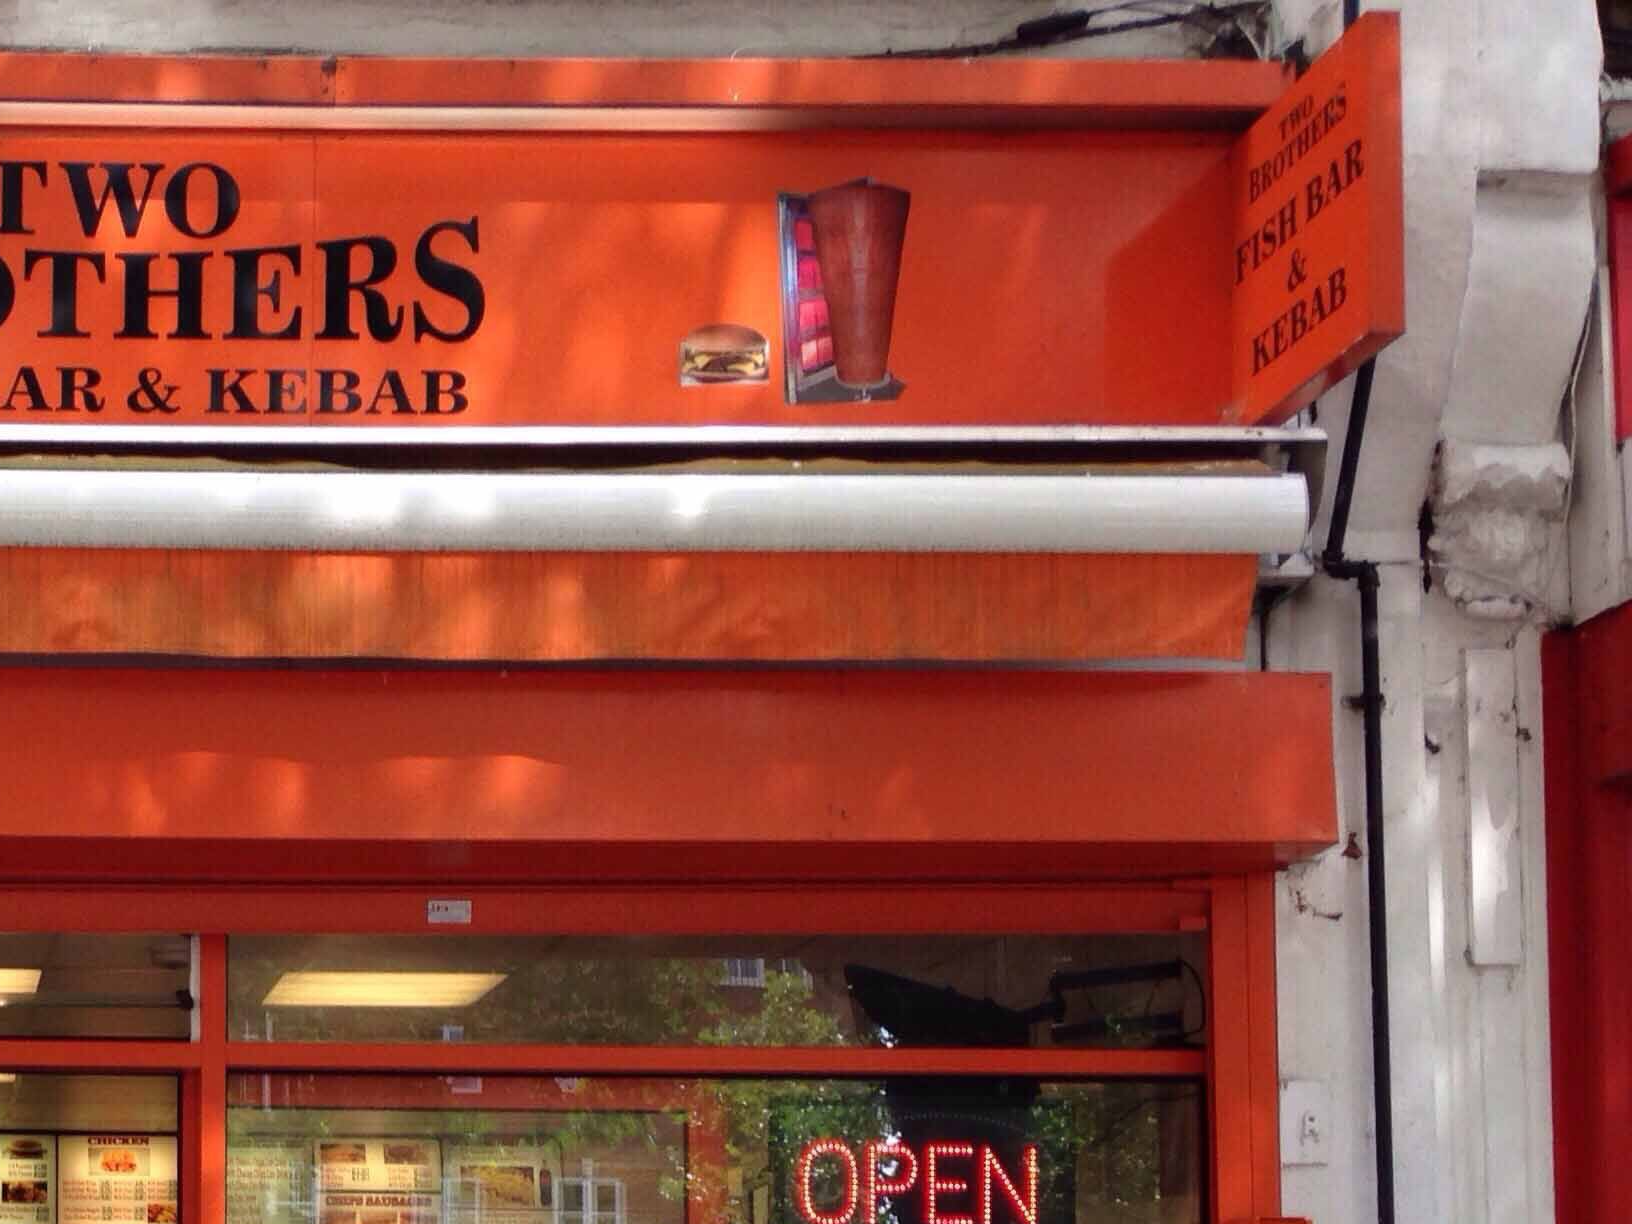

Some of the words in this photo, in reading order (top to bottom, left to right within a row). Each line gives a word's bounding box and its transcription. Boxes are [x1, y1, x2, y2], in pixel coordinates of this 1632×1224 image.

[1249, 82, 1347, 205] BROTHERS
[1279, 96, 1314, 140] TWO
[1235, 194, 1298, 286] FISH
[1305, 140, 1365, 223] BAR
[1287, 248, 1306, 293] &
[1252, 267, 1348, 376] KEBAB
[127, 366, 181, 413] &
[205, 367, 469, 416] KEBAB
